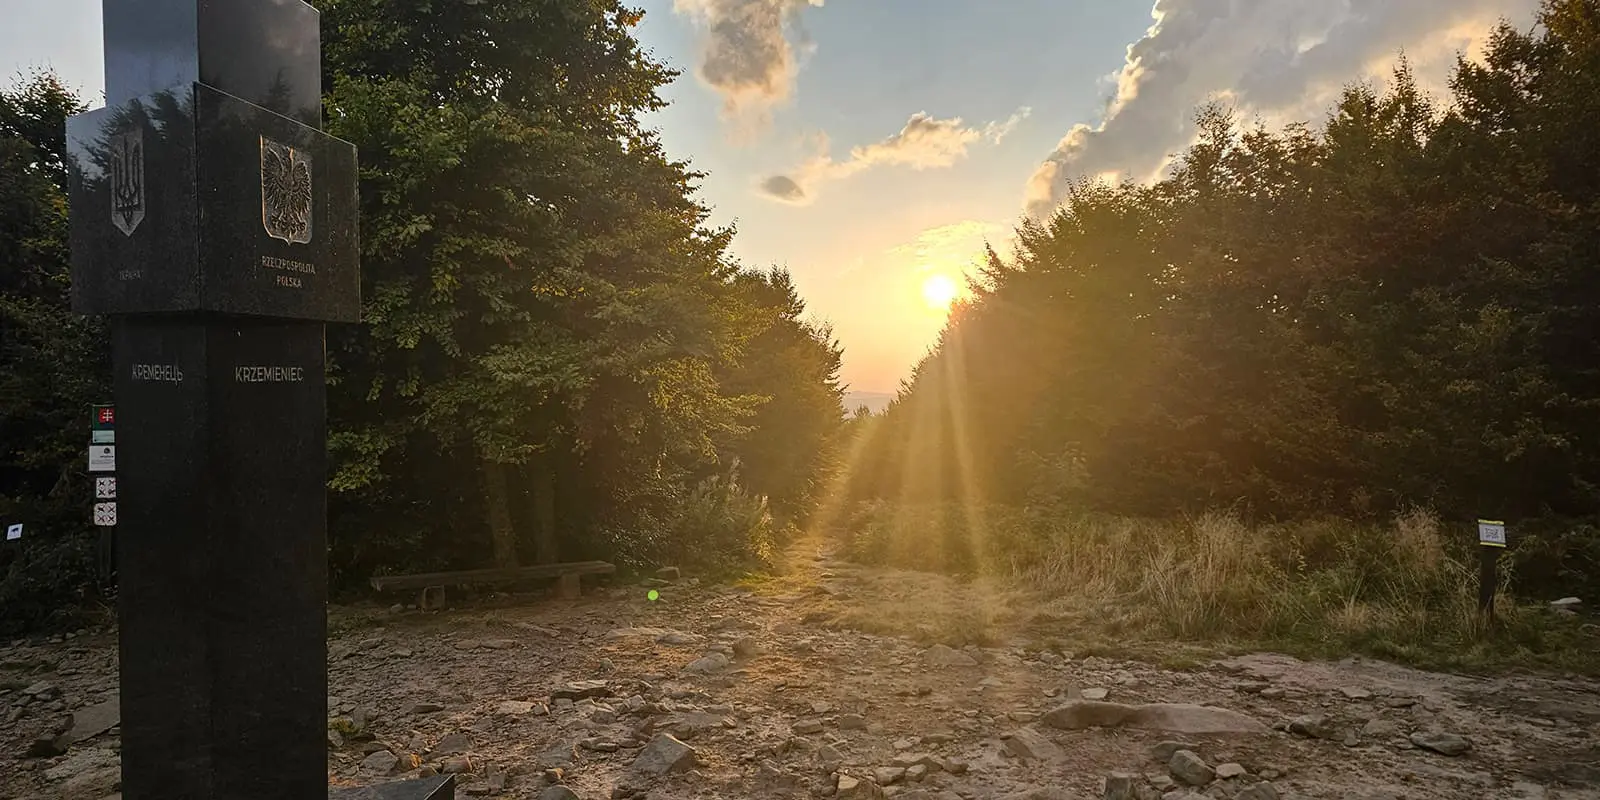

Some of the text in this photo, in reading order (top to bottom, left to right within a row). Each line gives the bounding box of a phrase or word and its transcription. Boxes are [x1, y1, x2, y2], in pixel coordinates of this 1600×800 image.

[262, 255, 316, 274] RZECZPOSPOLITA
[277, 275, 303, 288] POLSKA
[132, 364, 184, 385] КРЕМЕНЕЦЬ
[235, 366, 304, 382] KRZEMIENIEC
